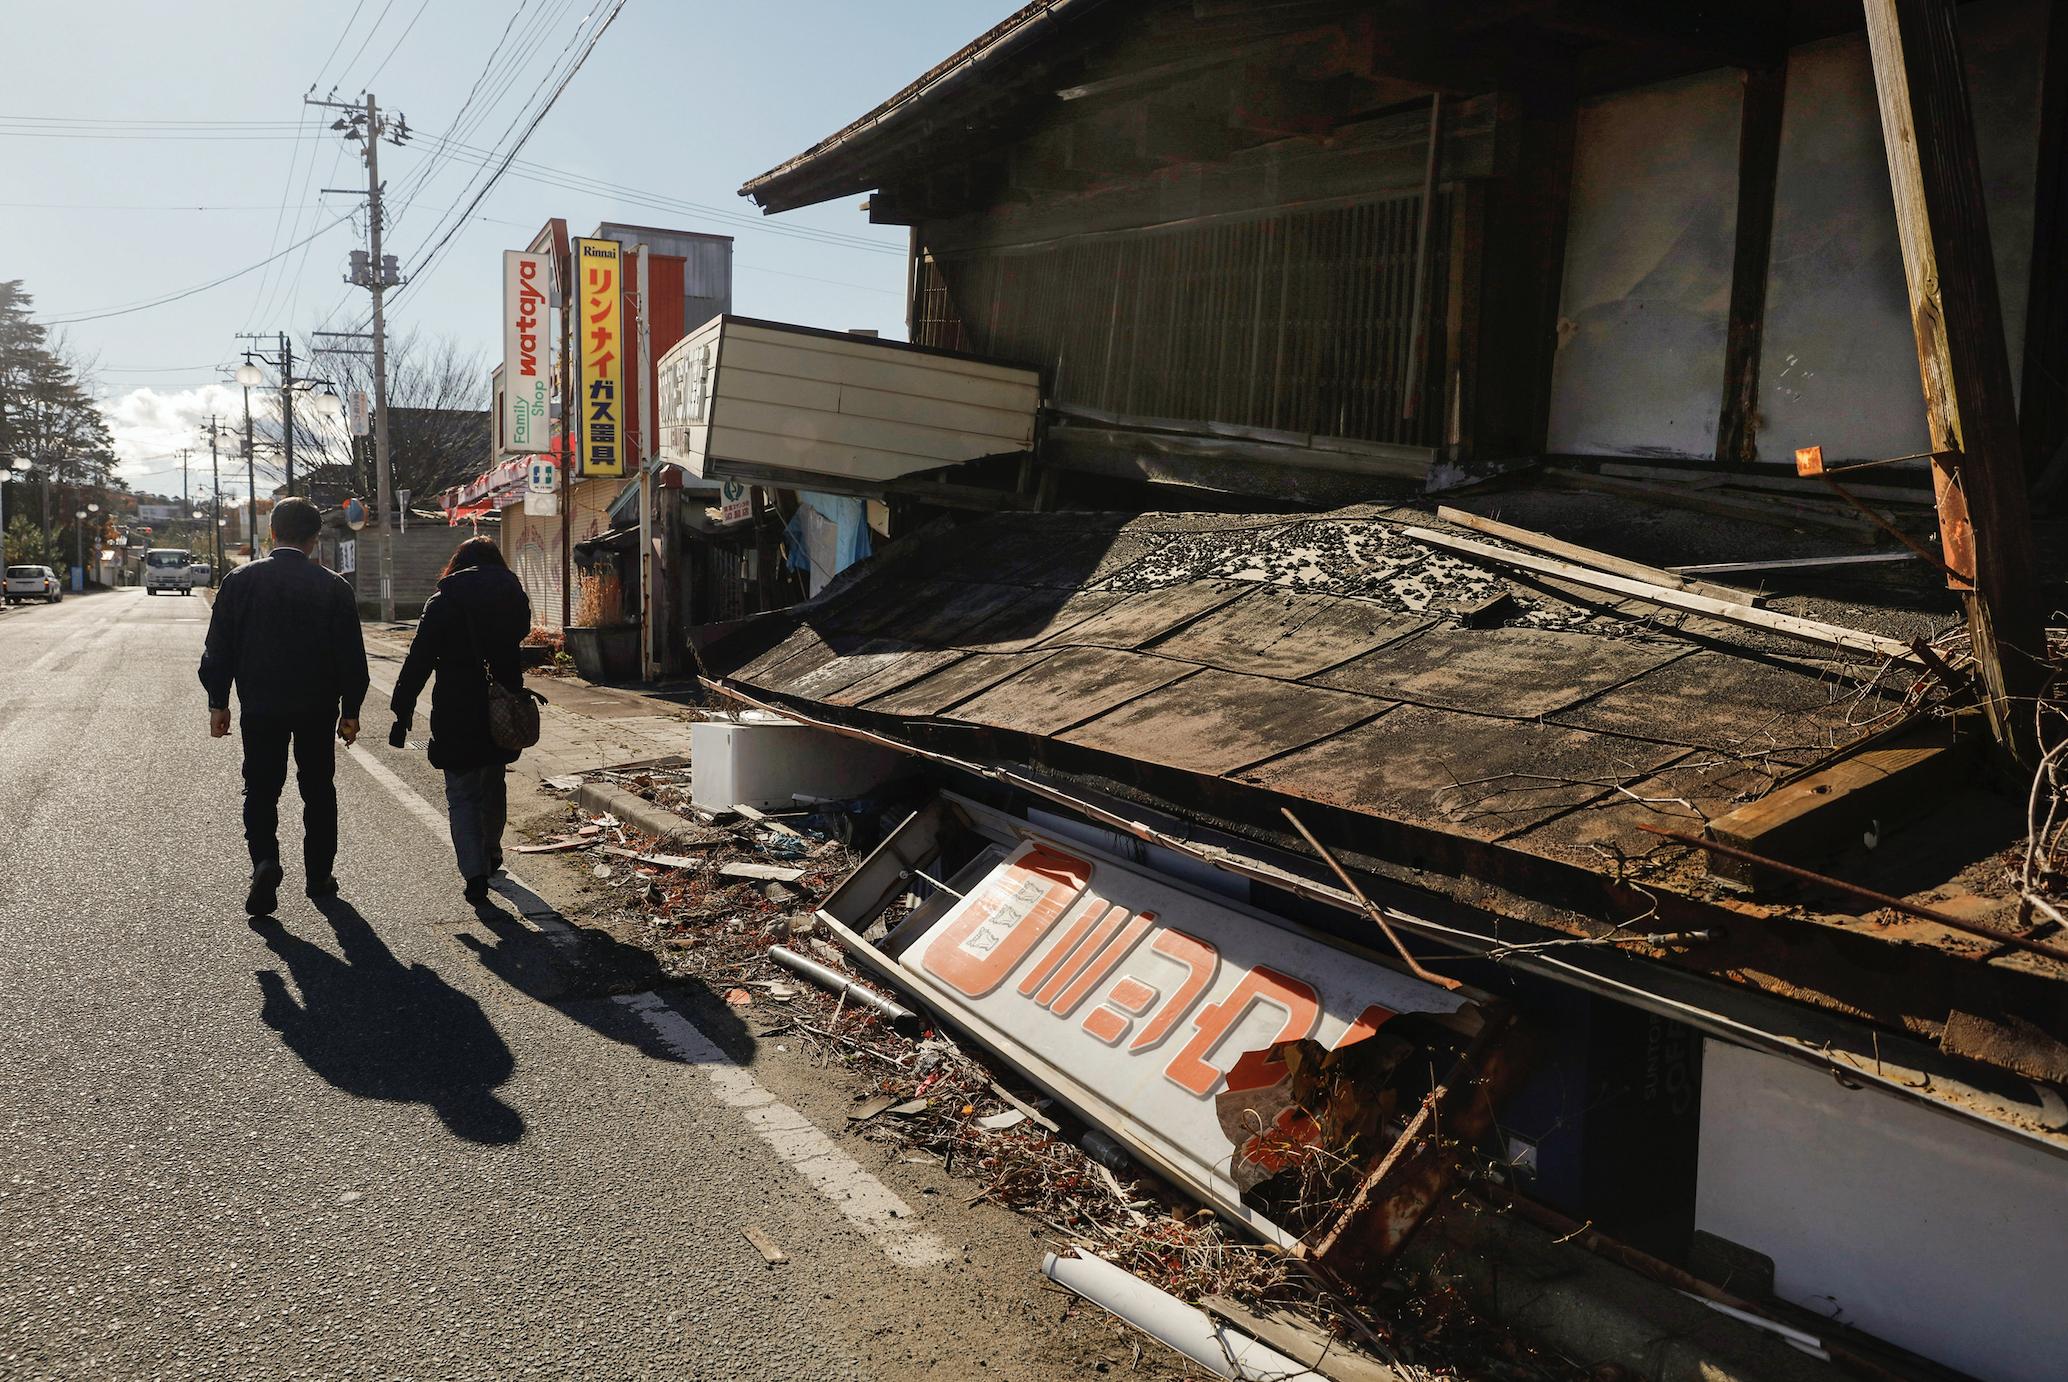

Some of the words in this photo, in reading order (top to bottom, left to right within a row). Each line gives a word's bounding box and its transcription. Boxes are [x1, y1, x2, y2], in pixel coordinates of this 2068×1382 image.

[583, 246, 617, 260] Rinnai
[516, 260, 546, 376] wataya
[531, 380, 548, 417] Shop
[588, 268, 617, 466] リンナイガス器具
[513, 395, 530, 444] Family
[1644, 1014, 1661, 1101] SUNTOR
